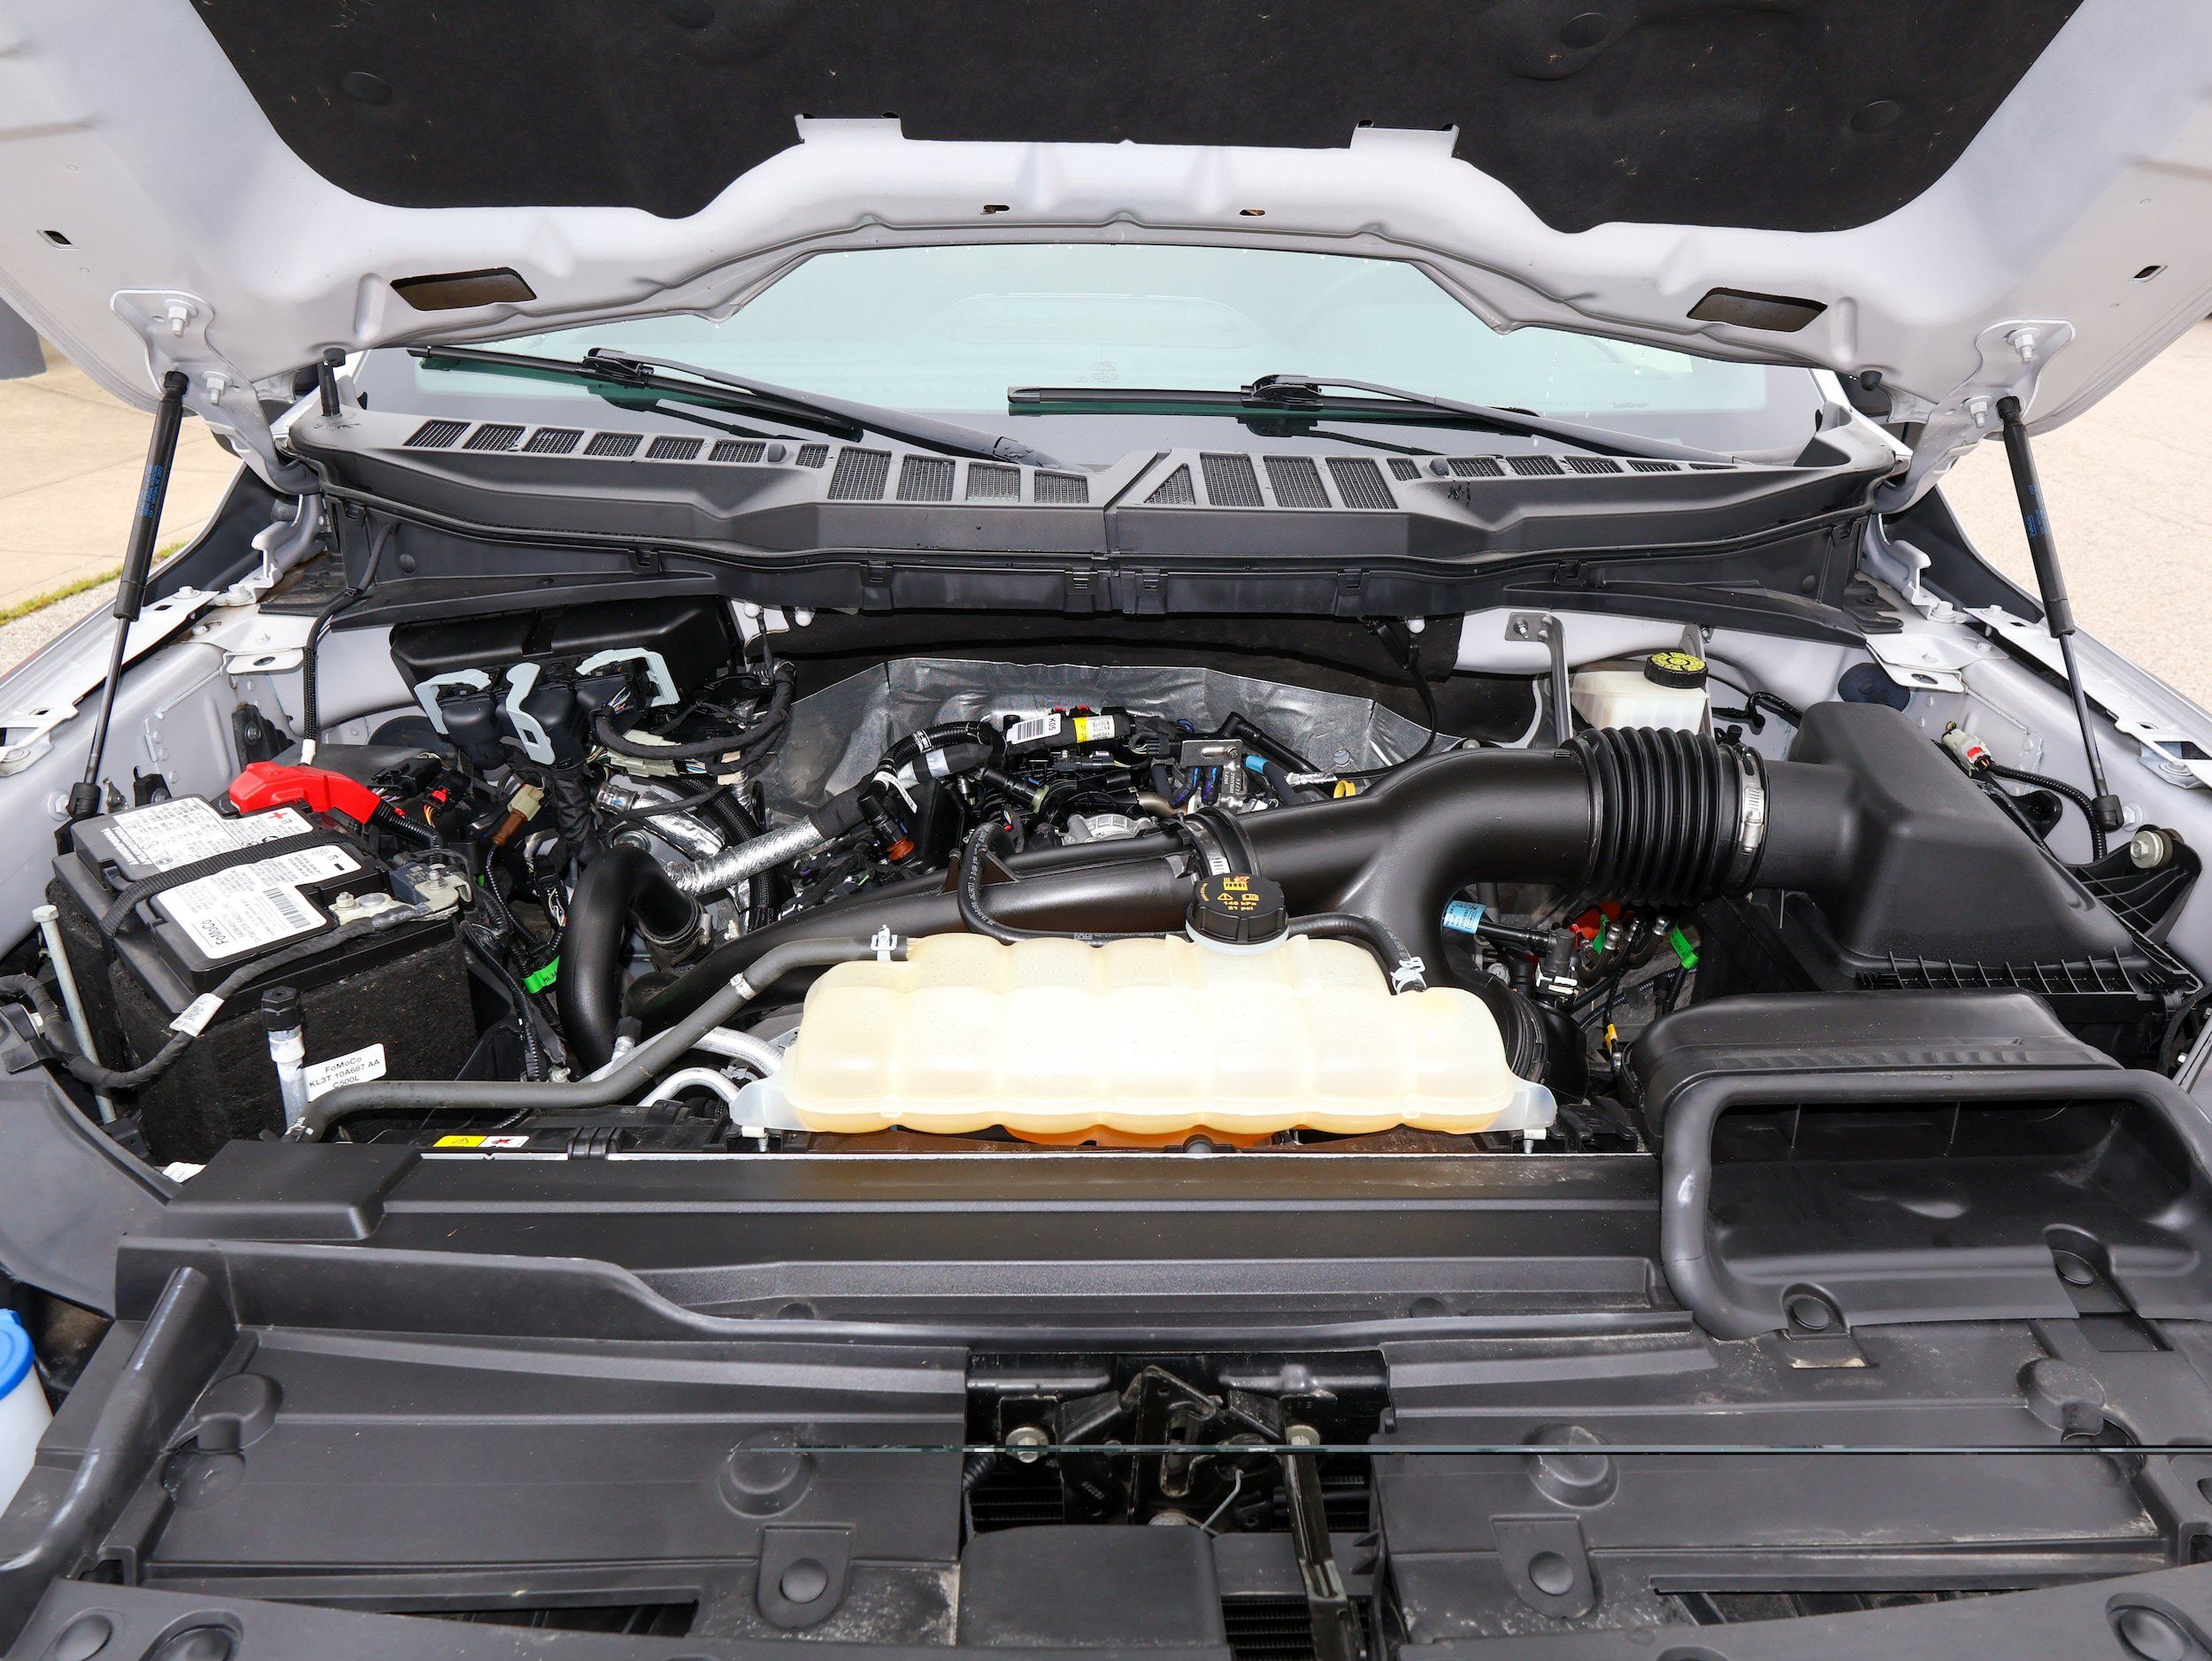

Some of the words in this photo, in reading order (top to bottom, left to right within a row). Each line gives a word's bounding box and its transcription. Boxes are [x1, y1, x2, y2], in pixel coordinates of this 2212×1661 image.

[202, 919, 229, 945] FoMoCo
[309, 1075, 332, 1088] KL3T
[334, 1064, 365, 1079] 10A687
[368, 1059, 380, 1068] AA
[325, 1057, 362, 1073] FoMoCo
[333, 1075, 360, 1089] C500L
